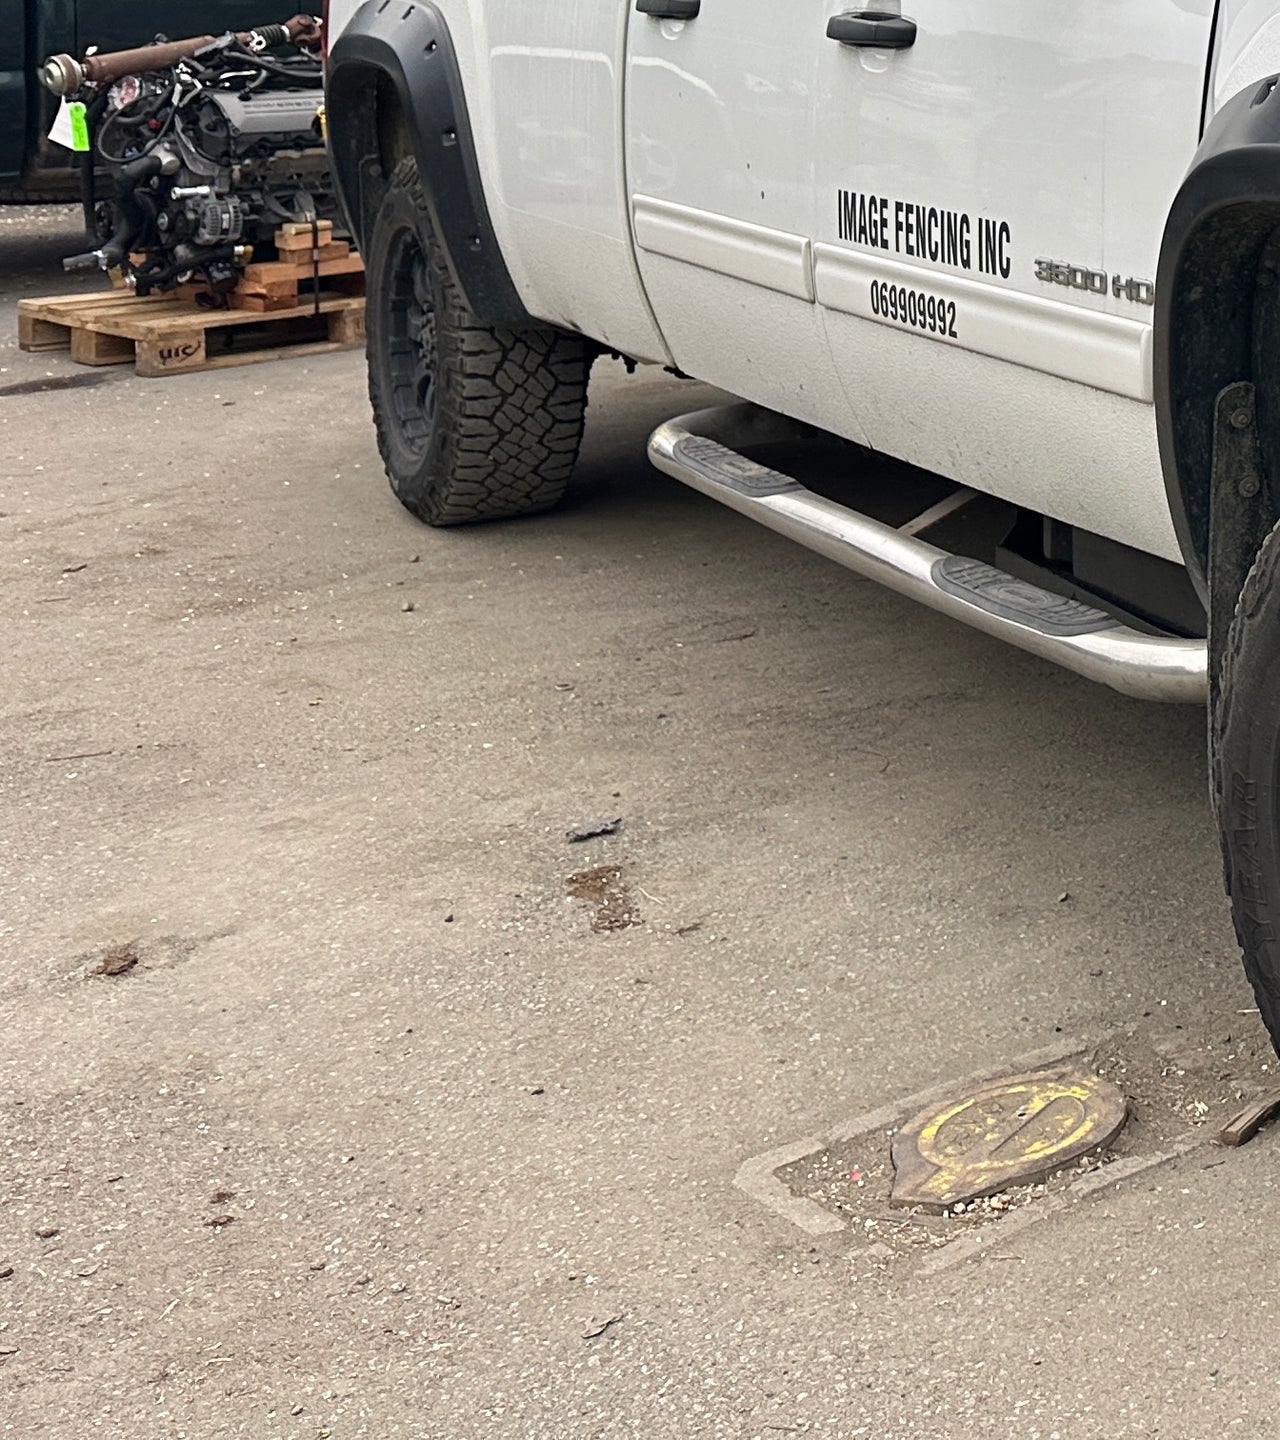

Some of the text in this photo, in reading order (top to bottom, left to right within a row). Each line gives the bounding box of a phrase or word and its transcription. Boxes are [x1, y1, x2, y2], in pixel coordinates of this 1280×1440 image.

[837, 189, 1011, 279] IMAGE FENCING INC
[1034, 257, 1108, 296] 3500
[870, 279, 958, 339] 069909992
